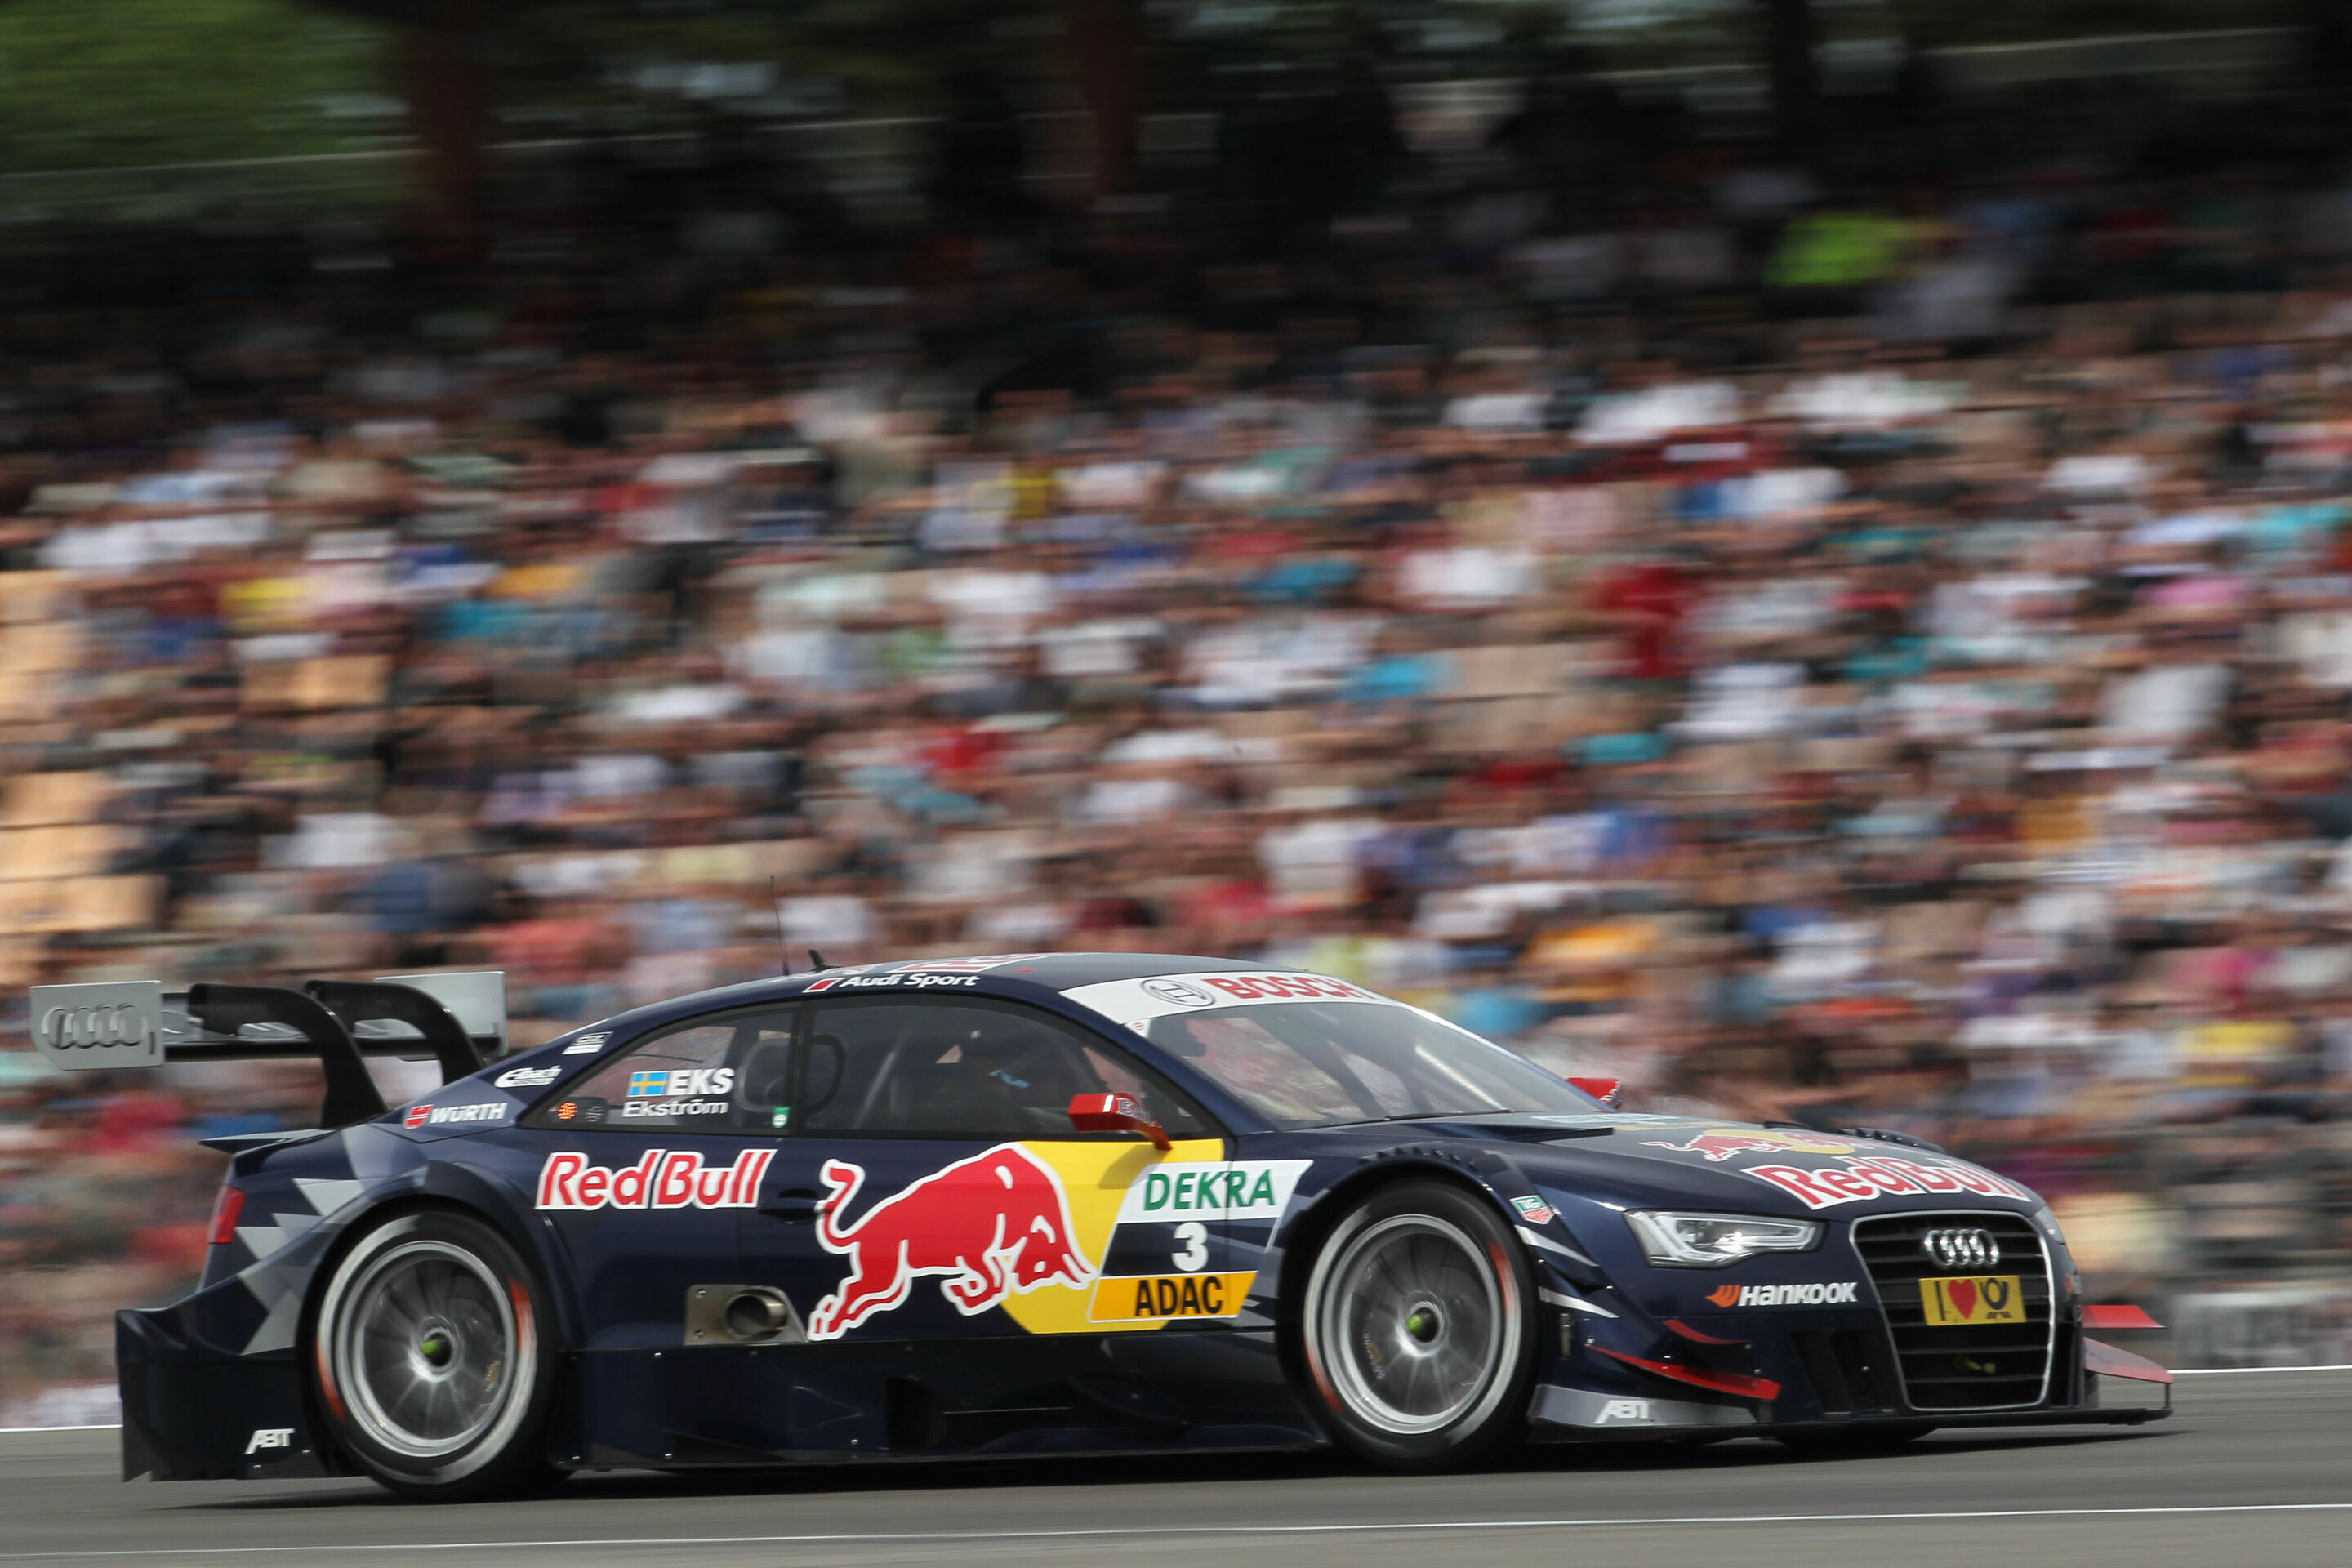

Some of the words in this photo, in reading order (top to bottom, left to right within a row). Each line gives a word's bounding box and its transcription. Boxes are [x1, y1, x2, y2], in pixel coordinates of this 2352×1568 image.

[840, 974, 901, 988] Audi
[904, 973, 980, 989] Sport
[1200, 975, 1379, 1000] BOSCH
[666, 1067, 735, 1096] EKS
[621, 1098, 729, 1118] Ekström
[1143, 1169, 1277, 1212] DEKRA
[1171, 1222, 1209, 1272] 3
[1134, 1276, 1223, 1316] ADAC
[1593, 1400, 1650, 1424] ABT
[244, 1428, 296, 1454] ABT
